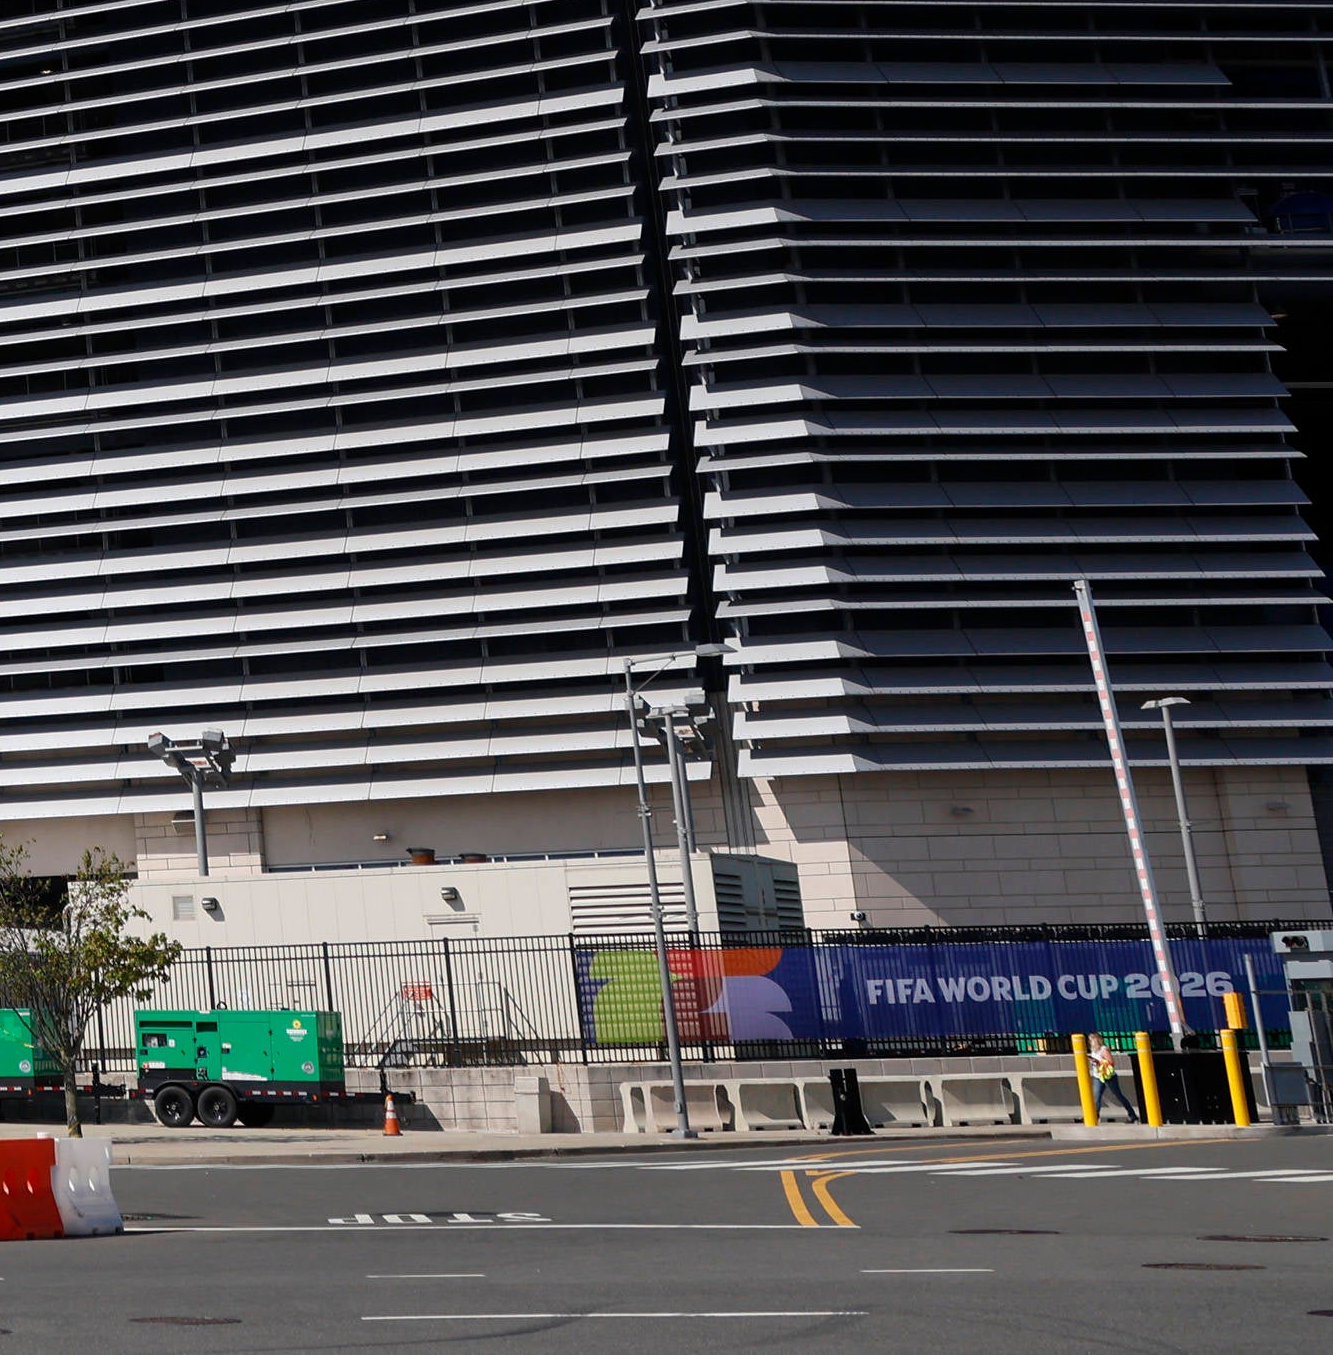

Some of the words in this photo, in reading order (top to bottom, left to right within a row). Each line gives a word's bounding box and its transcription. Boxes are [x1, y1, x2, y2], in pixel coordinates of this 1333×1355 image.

[866, 978, 935, 1005] FIFA
[936, 975, 1052, 1003] WORLD
[1057, 974, 1119, 1000] CUP
[327, 1212, 552, 1225] STOP
